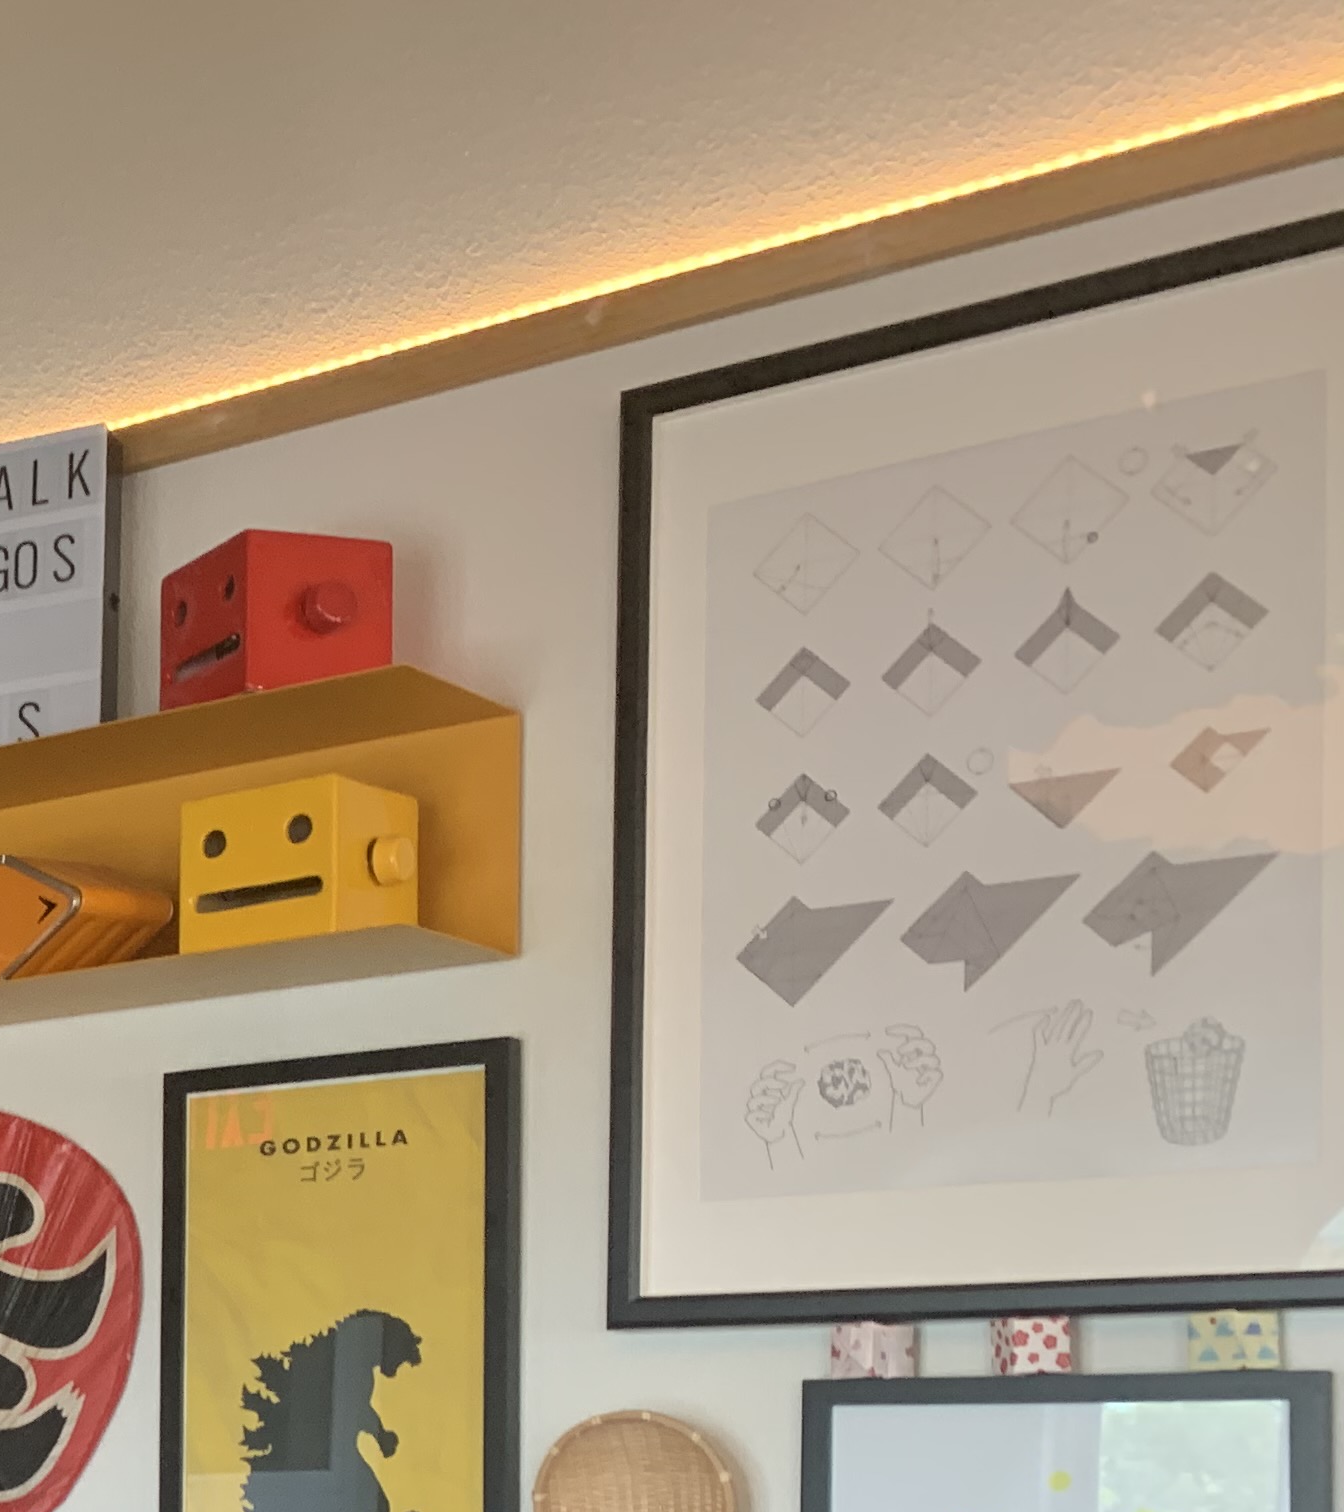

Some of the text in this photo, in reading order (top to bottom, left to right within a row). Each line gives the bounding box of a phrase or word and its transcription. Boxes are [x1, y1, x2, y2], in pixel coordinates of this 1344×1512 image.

[259, 1129, 409, 1156] GODZILLA
[300, 1158, 366, 1183] ゴジラ
